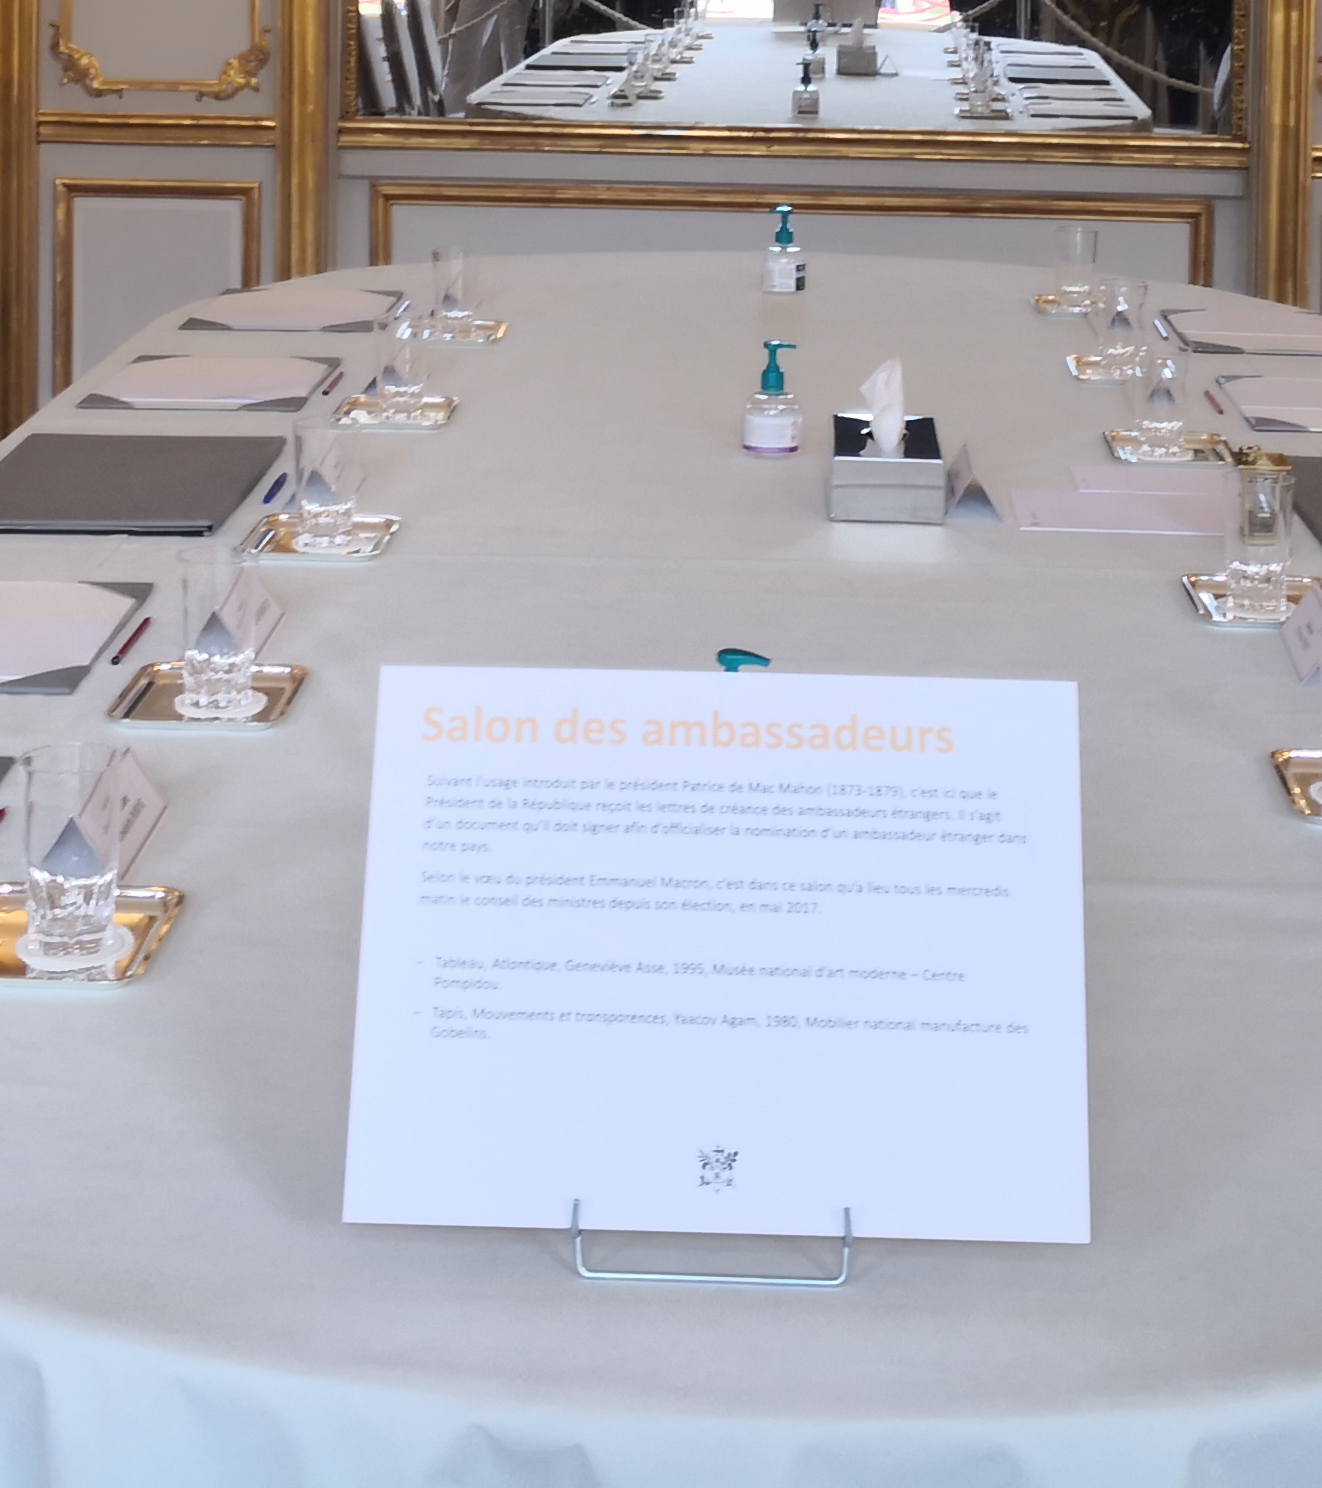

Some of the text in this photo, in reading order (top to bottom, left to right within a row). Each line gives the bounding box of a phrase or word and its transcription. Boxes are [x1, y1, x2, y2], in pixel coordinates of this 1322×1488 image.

[421, 705, 955, 752] Salon des ambassadeurs
[426, 774, 473, 787] Suivant
[475, 775, 519, 790] l'usage
[521, 777, 577, 789] introduit
[579, 779, 601, 791] par
[603, 778, 615, 790] le
[618, 778, 679, 792] président
[681, 779, 725, 792] Patrice
[727, 781, 745, 793] de
[746, 781, 775, 794] Mac
[777, 782, 823, 795] Mahon
[909, 787, 939, 798] c'est
[958, 789, 983, 802] que
[986, 789, 998, 800] le
[425, 796, 485, 808] Président
[486, 798, 504, 809] de
[506, 797, 518, 809] la
[634, 800, 653, 812] les
[655, 801, 697, 814] lettres
[699, 802, 716, 814] de
[717, 802, 769, 815] créance
[770, 803, 794, 816] des
[796, 806, 888, 818] ambassadeurs
[423, 817, 451, 830] d'un
[454, 819, 519, 831] document
[552, 820, 579, 832] doit
[581, 822, 620, 836] signer
[622, 820, 647, 834] afin
[728, 824, 741, 836] la
[743, 826, 817, 838] nomination
[819, 826, 849, 839] d'un
[851, 828, 937, 841] ambassadeur
[939, 831, 994, 845] étranger
[996, 832, 1027, 844] dans
[421, 840, 494, 854] notre pays.
[420, 870, 455, 883] Selon
[458, 871, 471, 884] le
[504, 873, 522, 885] du
[523, 873, 585, 887] président
[587, 874, 657, 887] Emmanuel
[659, 876, 713, 891] Macron,
[715, 877, 745, 890] c'est
[747, 878, 779, 891] dans
[780, 881, 797, 892] ce
[798, 880, 834, 892] salon
[866, 881, 890, 894] lieu
[892, 884, 922, 895] tous
[923, 884, 943, 896] les
[945, 884, 1010, 897] mercredis
[418, 894, 456, 905] matin
[458, 895, 471, 905] le
[473, 894, 519, 907] conseil
[520, 895, 544, 908] des
[546, 897, 606, 908] ministres
[607, 897, 651, 911] depuis
[653, 900, 677, 911] son
[679, 899, 736, 914] élection,
[737, 902, 756, 912] en
[757, 902, 783, 913] mai
[435, 956, 487, 970] Tableau,
[634, 961, 669, 975] Asse,
[711, 963, 756, 976] Musée
[758, 965, 812, 977] national
[813, 965, 845, 978] d'art
[847, 968, 907, 980] moderne
[921, 968, 965, 981] Centre
[432, 976, 502, 991] Pompidou.
[429, 1025, 491, 1039] Gobelins.
[471, 1008, 555, 1021] Mouvements
[557, 1010, 572, 1022] et
[719, 1013, 761, 1030] Agam,
[803, 1016, 859, 1029] Mobilier
[862, 1019, 916, 1030] national
[919, 1018, 1003, 1033] manufacture
[1005, 1022, 1029, 1034] des
